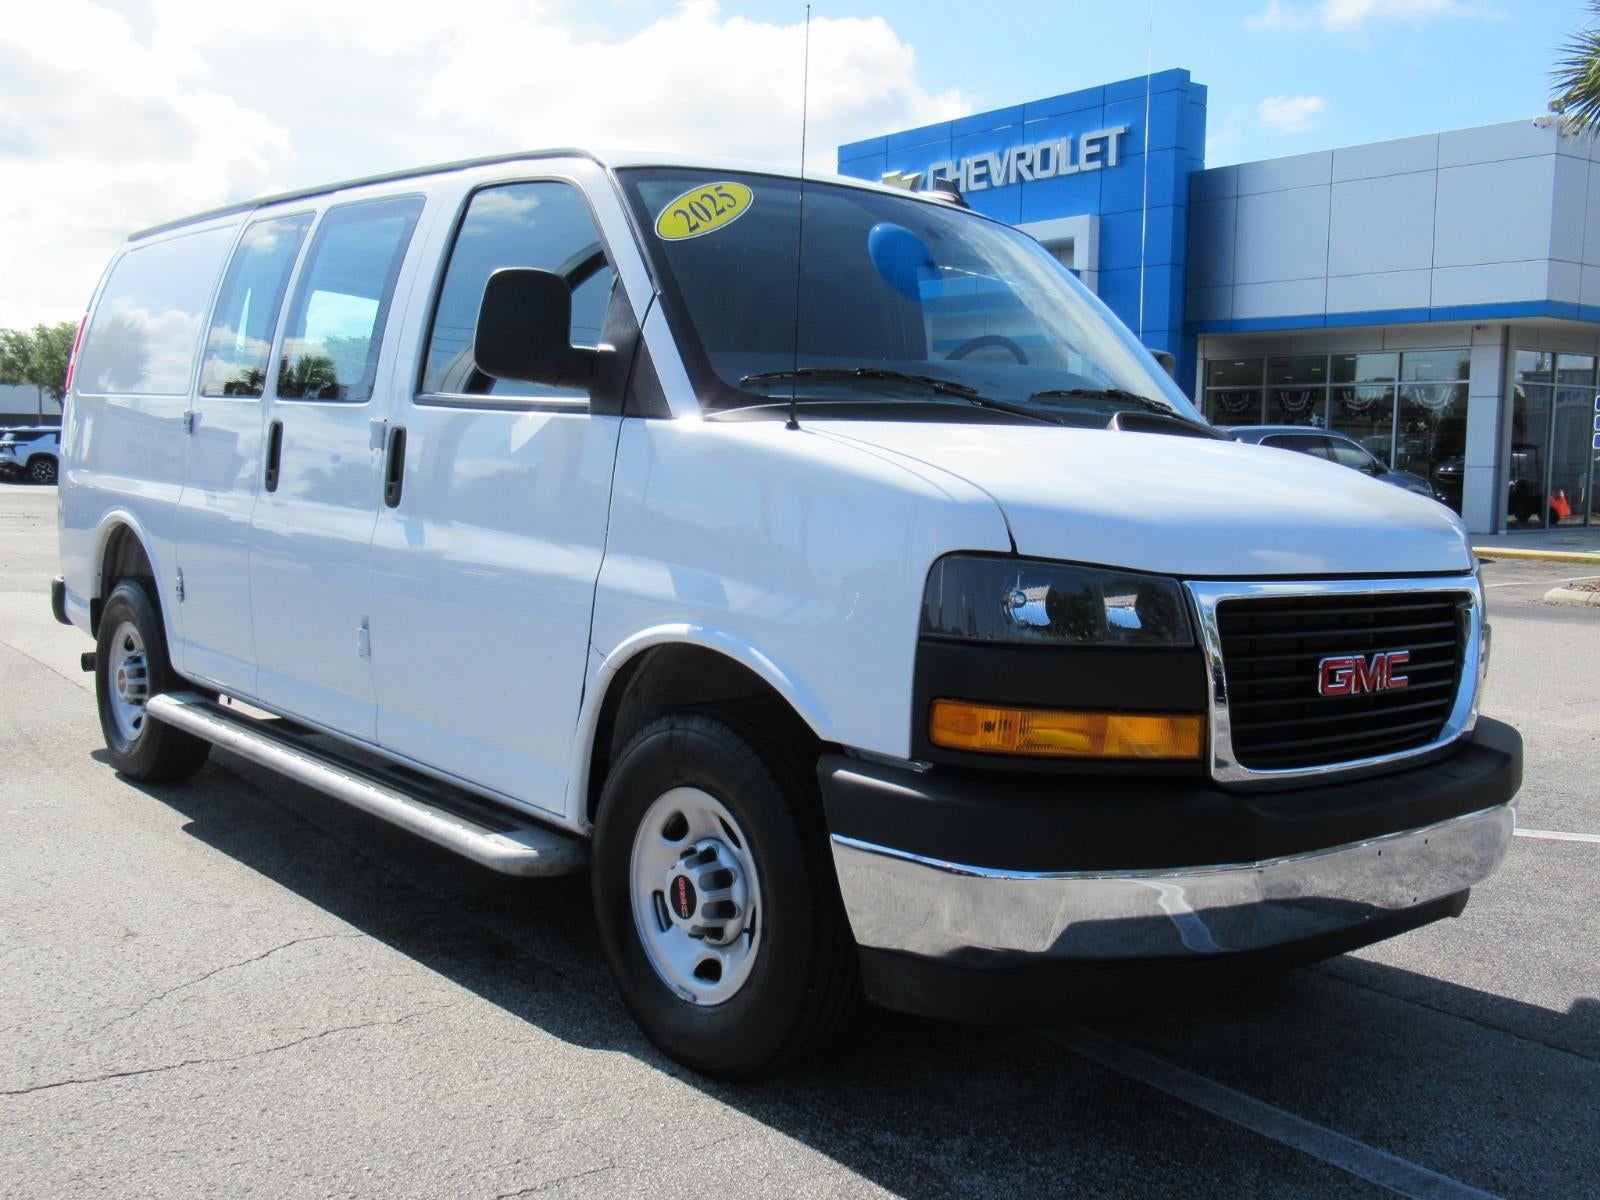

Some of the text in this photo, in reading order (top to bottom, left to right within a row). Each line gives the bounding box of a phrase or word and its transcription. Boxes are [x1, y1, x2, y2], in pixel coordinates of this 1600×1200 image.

[927, 125, 1127, 193] CHEVROLET
[673, 185, 737, 233] 2025
[1318, 650, 1409, 696] GMC
